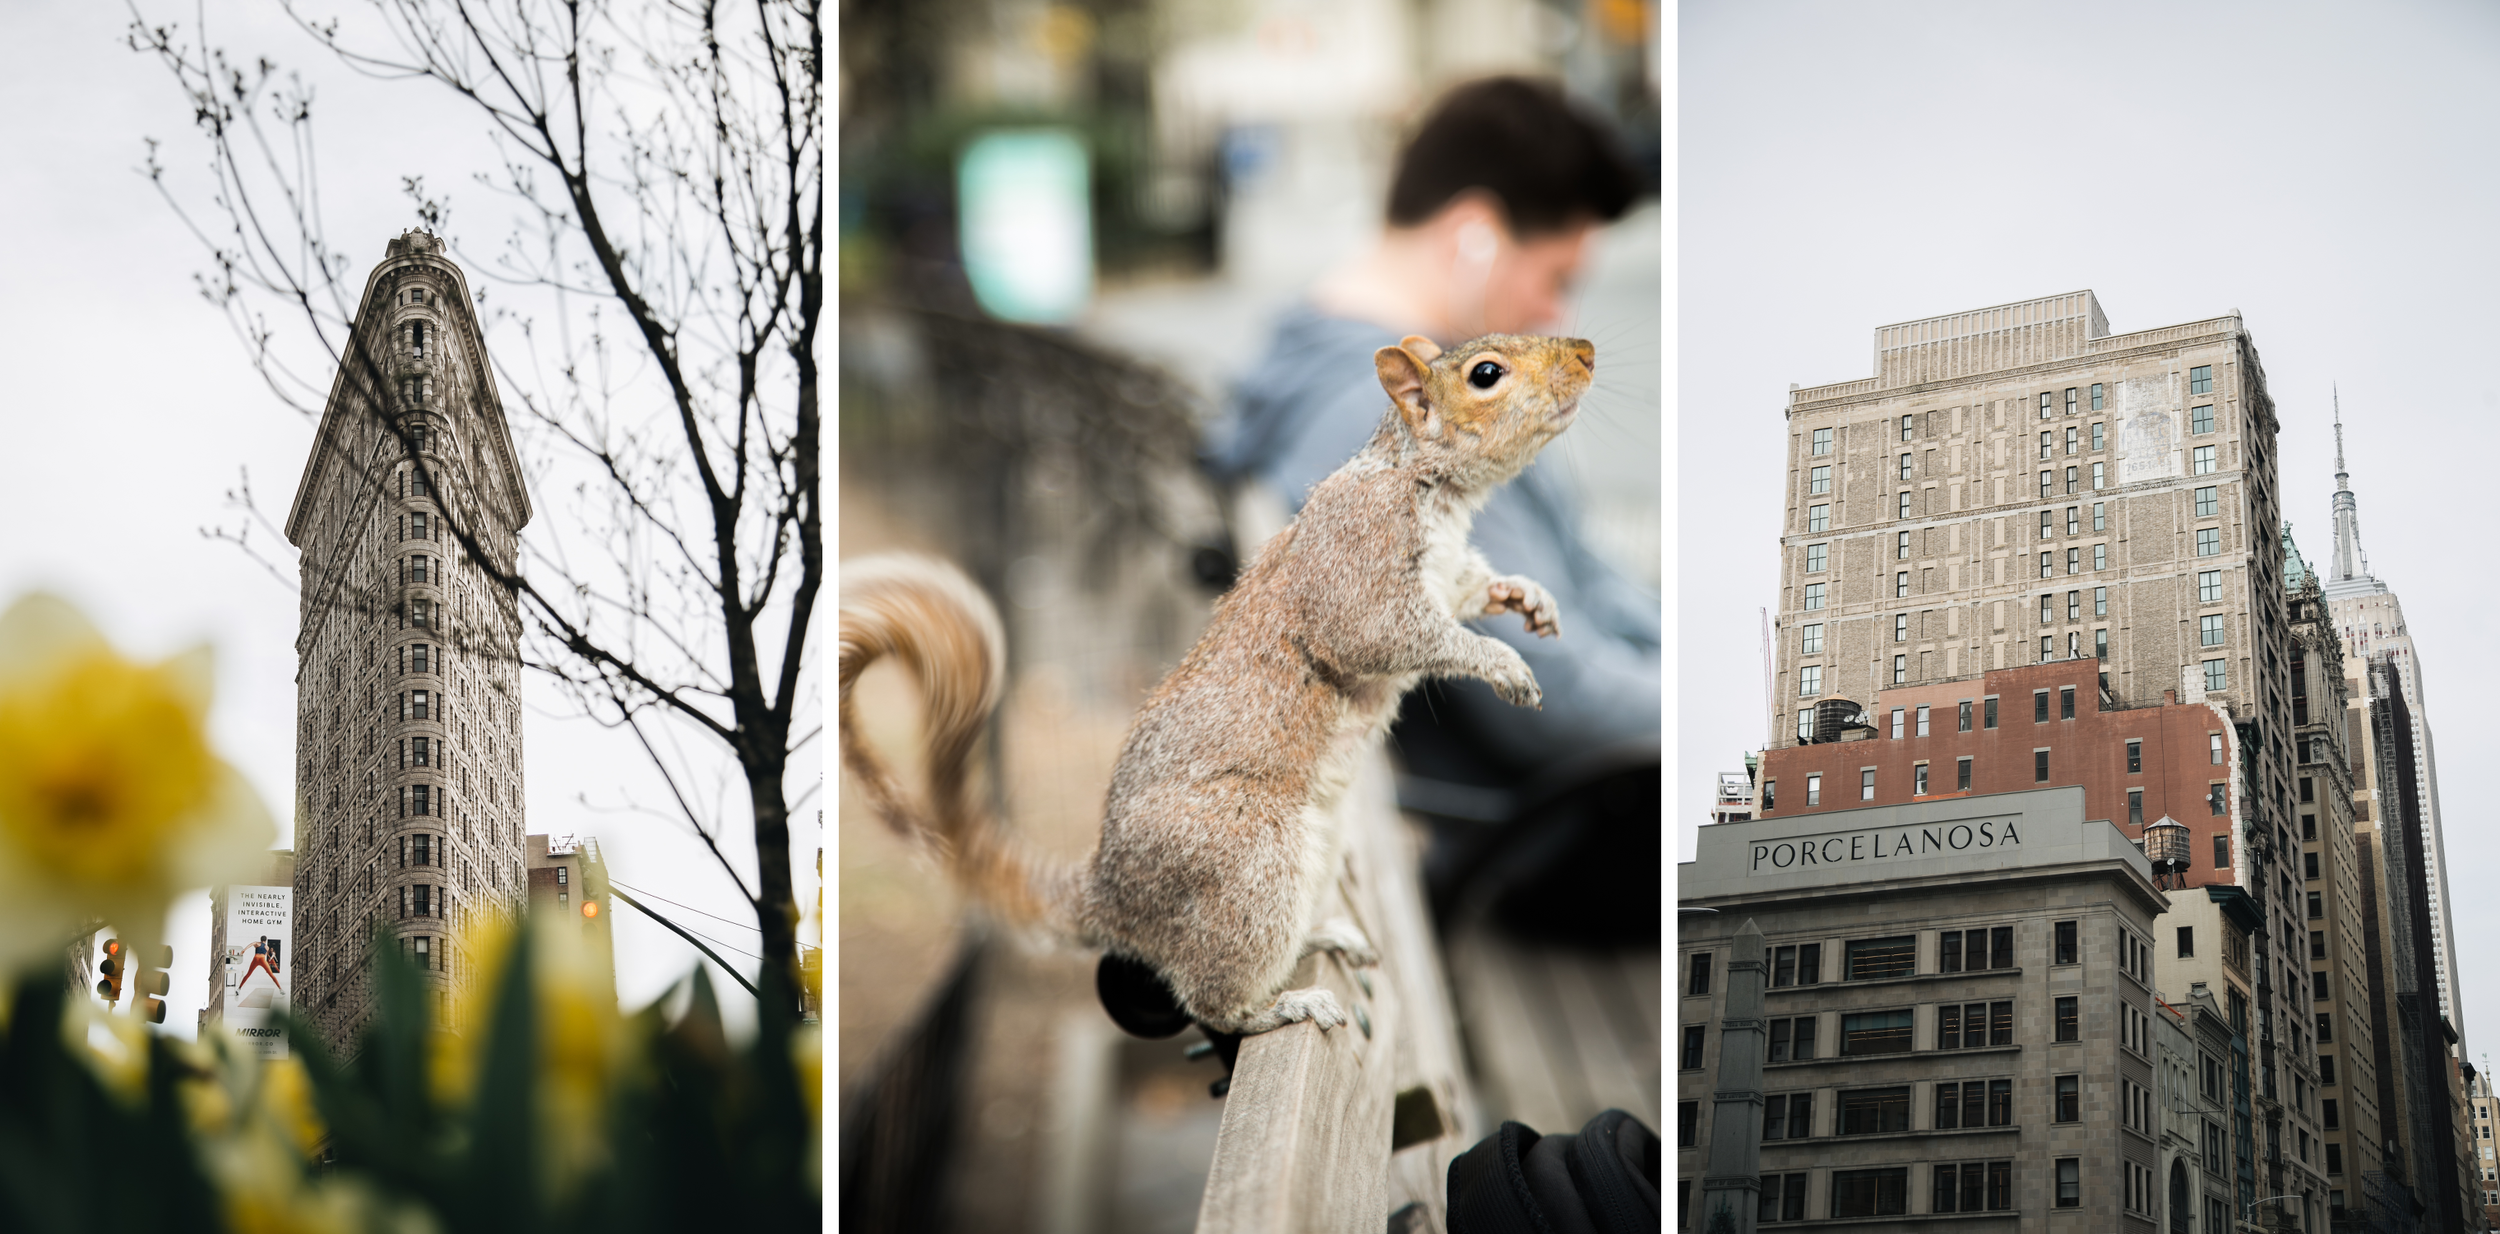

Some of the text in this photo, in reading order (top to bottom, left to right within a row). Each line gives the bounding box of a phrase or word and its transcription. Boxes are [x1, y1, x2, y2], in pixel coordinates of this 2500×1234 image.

[1753, 821, 2020, 871] PORCELANOSA
[237, 909, 287, 917] INTERACTIVE
[235, 1028, 281, 1037] MIRROR
